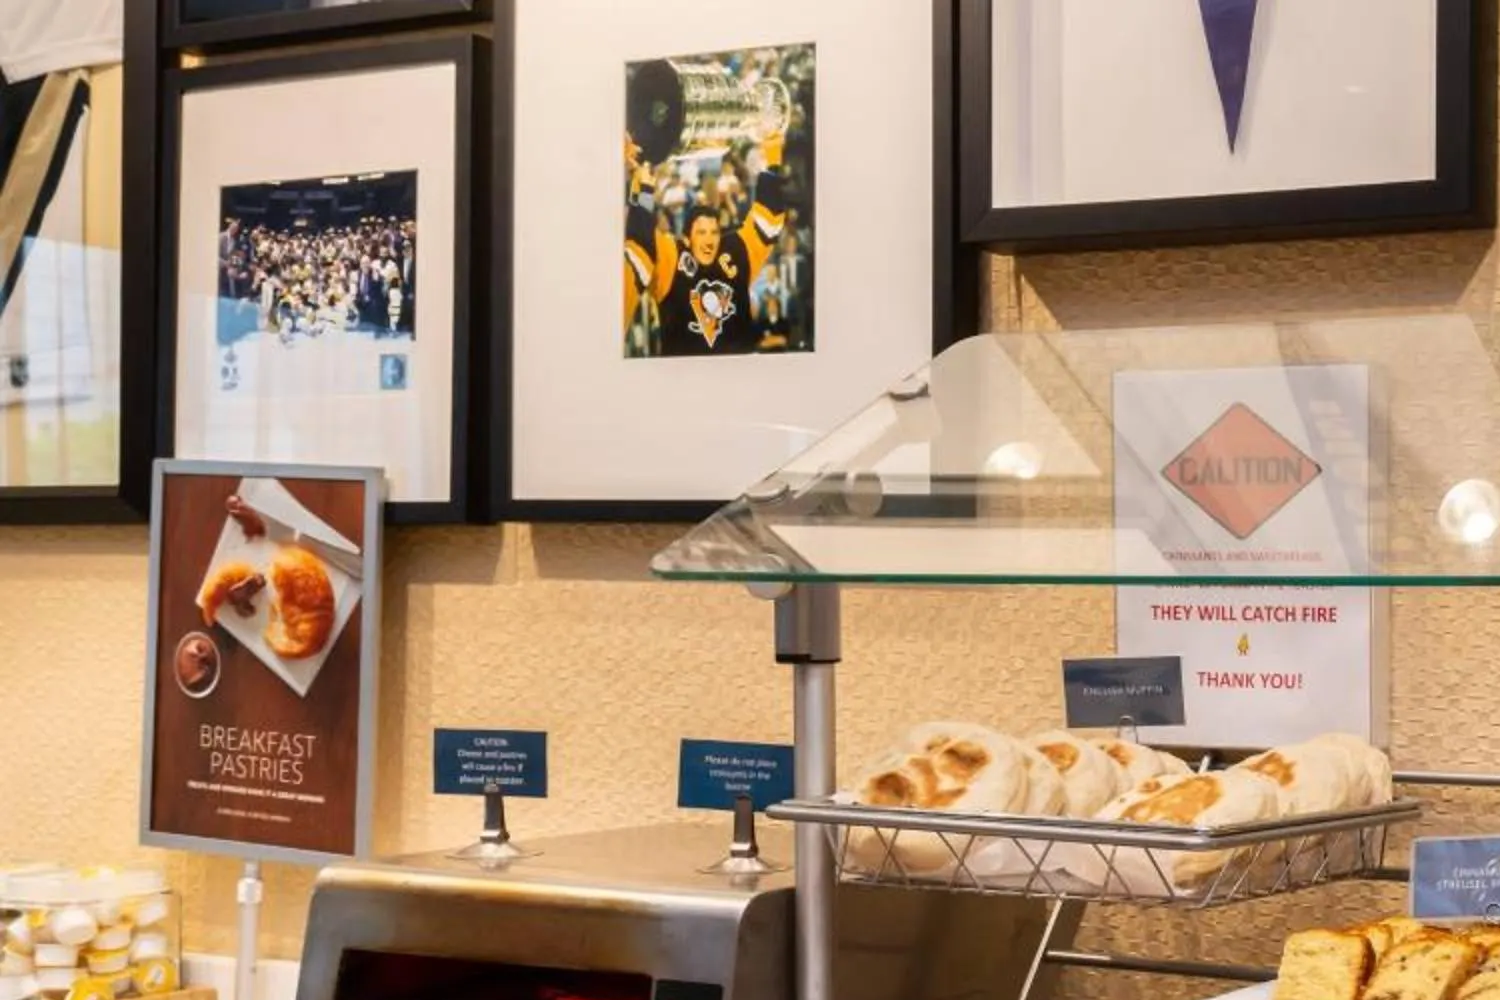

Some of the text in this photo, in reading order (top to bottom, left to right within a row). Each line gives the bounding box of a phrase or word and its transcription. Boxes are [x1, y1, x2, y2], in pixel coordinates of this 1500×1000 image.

[1150, 605, 1338, 623] THEY WILL CATCH FIRE
[1196, 671, 1303, 690] THANK YOU!
[199, 722, 317, 760] BREAKFAST
[210, 751, 304, 785] PASTRIES
